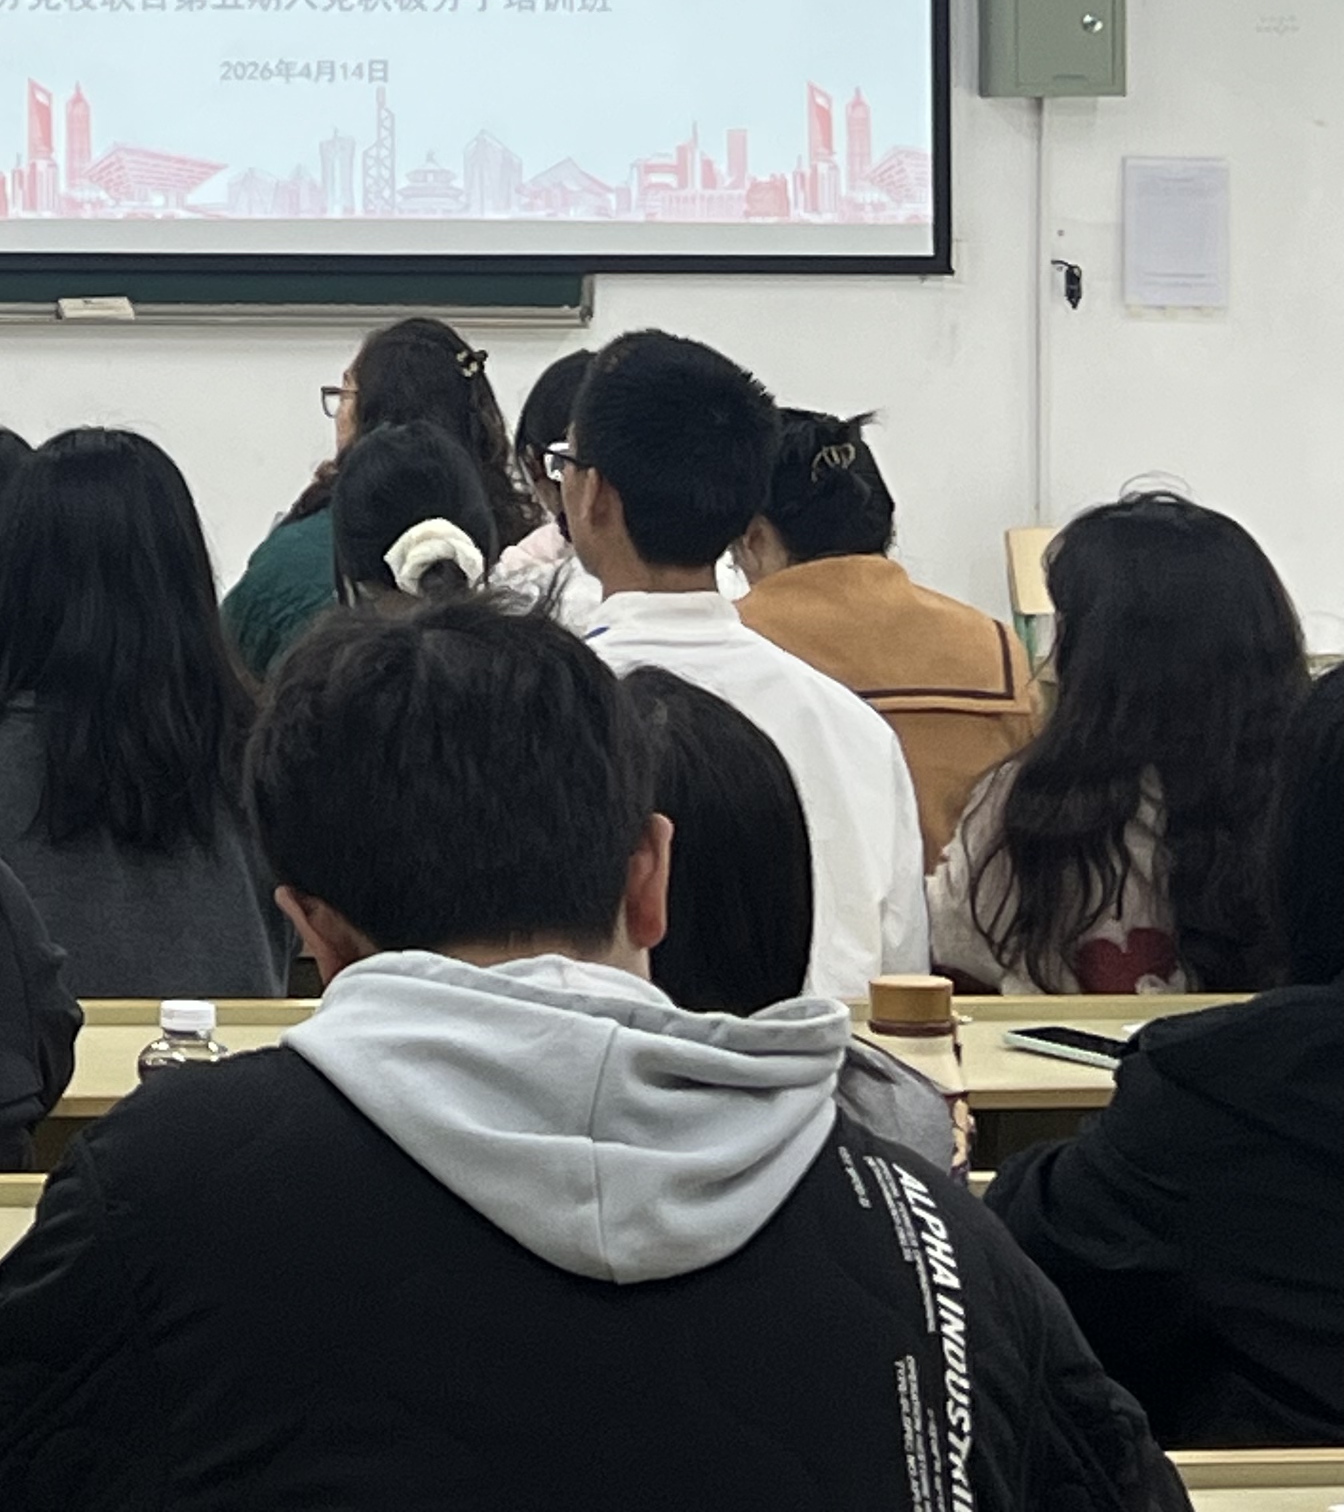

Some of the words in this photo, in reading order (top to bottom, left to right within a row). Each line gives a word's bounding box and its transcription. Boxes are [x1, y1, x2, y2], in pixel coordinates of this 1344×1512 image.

[219, 59, 389, 84] 2026年4月14日
[891, 1162, 963, 1291] ALPHA
